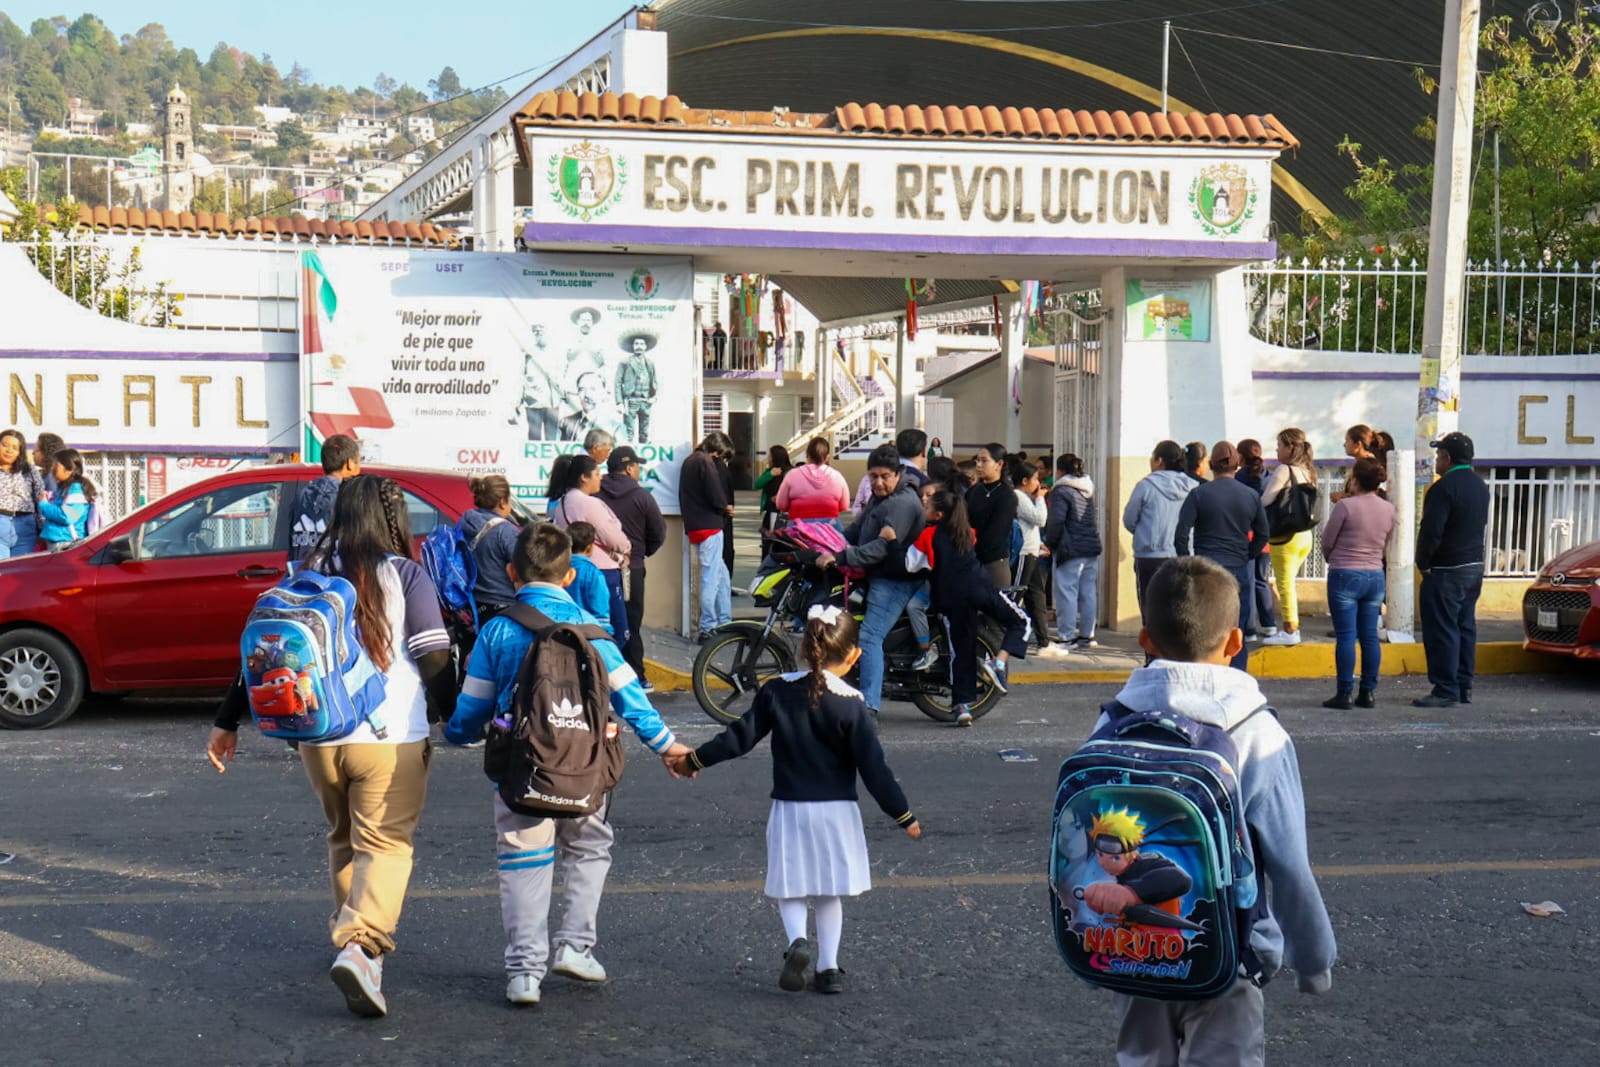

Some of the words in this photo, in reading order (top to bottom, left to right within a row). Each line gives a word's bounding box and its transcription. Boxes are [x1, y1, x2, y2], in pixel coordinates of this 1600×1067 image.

[643, 154, 727, 213] ESC.
[746, 158, 874, 219] PRIM.
[896, 163, 1170, 225] REVOLUCION
[436, 263, 464, 273] USET
[443, 309, 482, 326] morir
[403, 332, 420, 348] de
[423, 332, 445, 352] pie
[448, 337, 474, 352] que
[391, 354, 422, 371] vivir
[424, 356, 456, 372] toda
[459, 360, 485, 372] una
[381, 377, 412, 394] vida
[1518, 394, 1595, 446] CL
[192, 457, 231, 469] RED
[457, 449, 500, 464] CXIV
[547, 713, 590, 731] adidas
[541, 794, 574, 806] adidas
[1083, 925, 1184, 961] NARUTO
